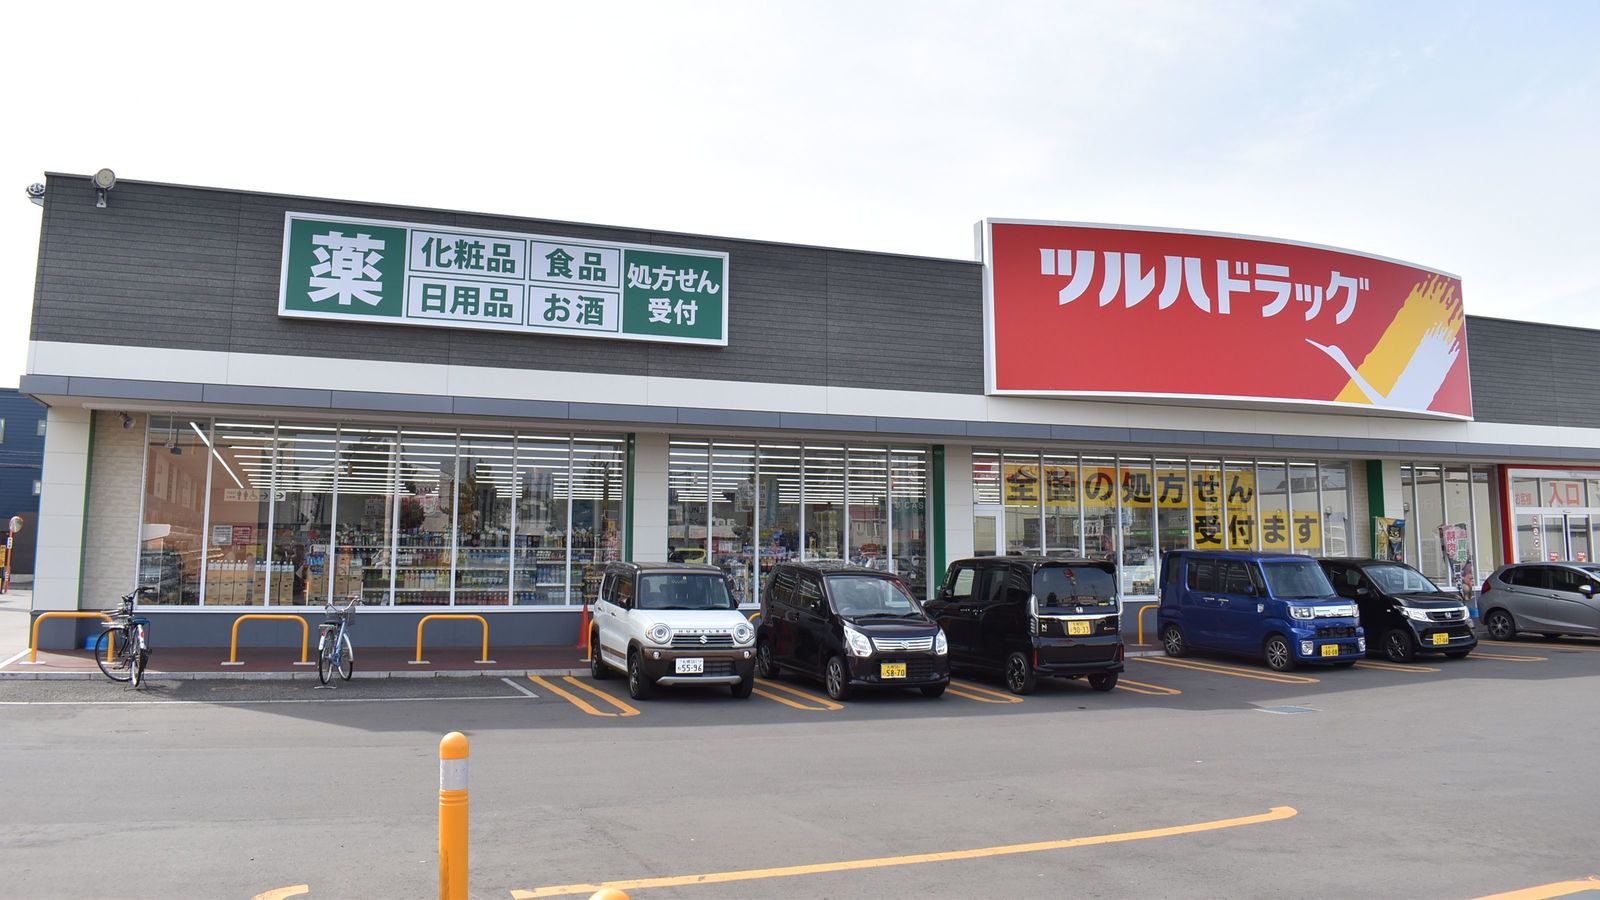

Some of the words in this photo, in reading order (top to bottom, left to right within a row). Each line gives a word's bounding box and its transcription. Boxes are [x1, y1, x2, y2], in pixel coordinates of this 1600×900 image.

[307, 231, 385, 307] 薬
[421, 237, 516, 274] 化粧品
[545, 248, 607, 282] 食品
[627, 263, 720, 295] 処方せん
[1039, 248, 1370, 325] ツルハドラッグ
[421, 283, 513, 319] 日用品
[543, 293, 605, 326] お酒
[648, 298, 698, 326] 受付
[1006, 467, 1254, 505] 全国の処方せん
[1547, 482, 1580, 506] 入口
[1194, 514, 1319, 546] 受付ます
